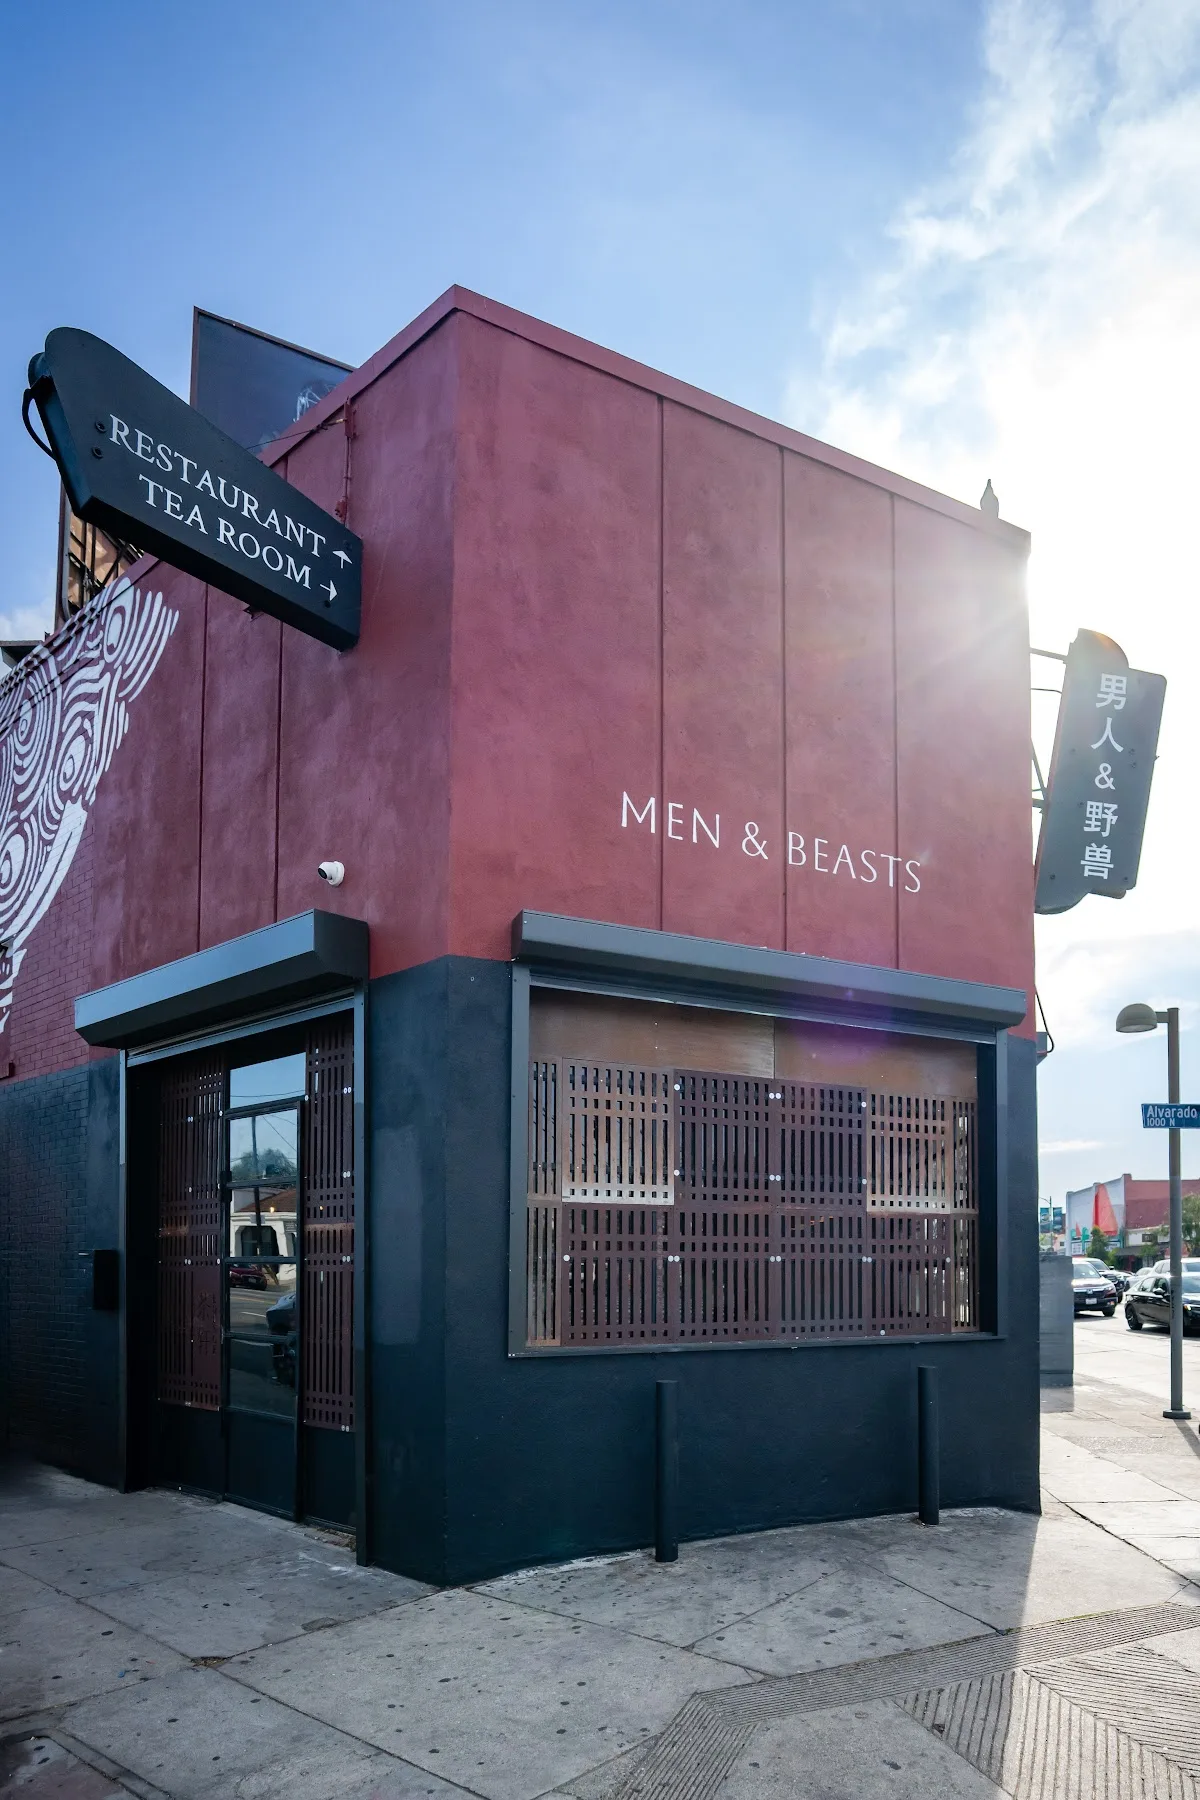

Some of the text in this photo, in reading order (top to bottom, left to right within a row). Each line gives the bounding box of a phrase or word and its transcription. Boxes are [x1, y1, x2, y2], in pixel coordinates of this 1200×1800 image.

[109, 414, 326, 557] RESTAURANT
[138, 474, 312, 589] TEA ROOM
[621, 791, 921, 893] MEN & BEASTS
[1146, 1118, 1176, 1127] 1000 N
[1147, 1105, 1198, 1118] Alvarado
